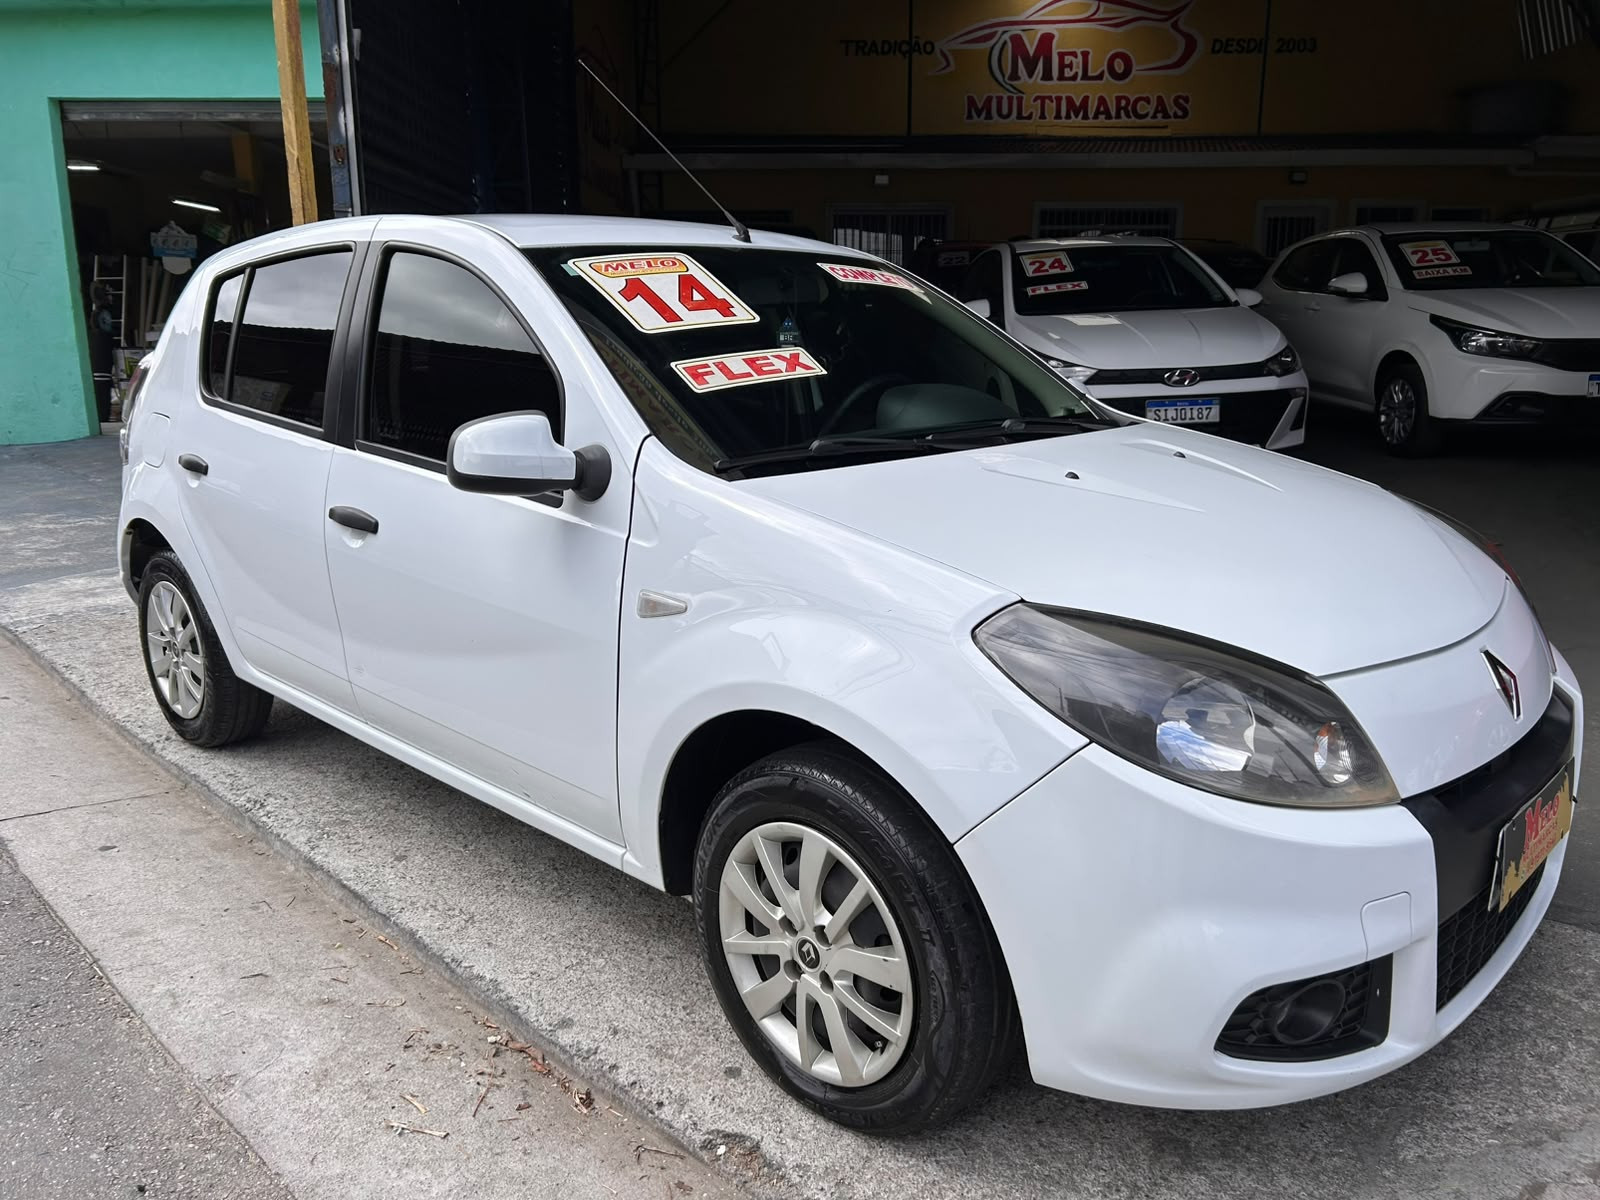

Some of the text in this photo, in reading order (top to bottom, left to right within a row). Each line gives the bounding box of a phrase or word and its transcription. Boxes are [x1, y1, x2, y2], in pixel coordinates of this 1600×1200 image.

[840, 36, 935, 59] TRADIÇÃO
[1275, 38, 1317, 54] 2003
[1006, 32, 1134, 82] MELO
[964, 94, 1190, 121] MULTIMARCAS
[603, 257, 679, 273] MELO
[1410, 247, 1453, 265] 25
[1029, 257, 1067, 275] 24
[1416, 267, 1470, 278] BAIXA KM
[1030, 282, 1083, 294] FLEX
[618, 273, 738, 323] 14
[682, 352, 816, 386] FLEX
